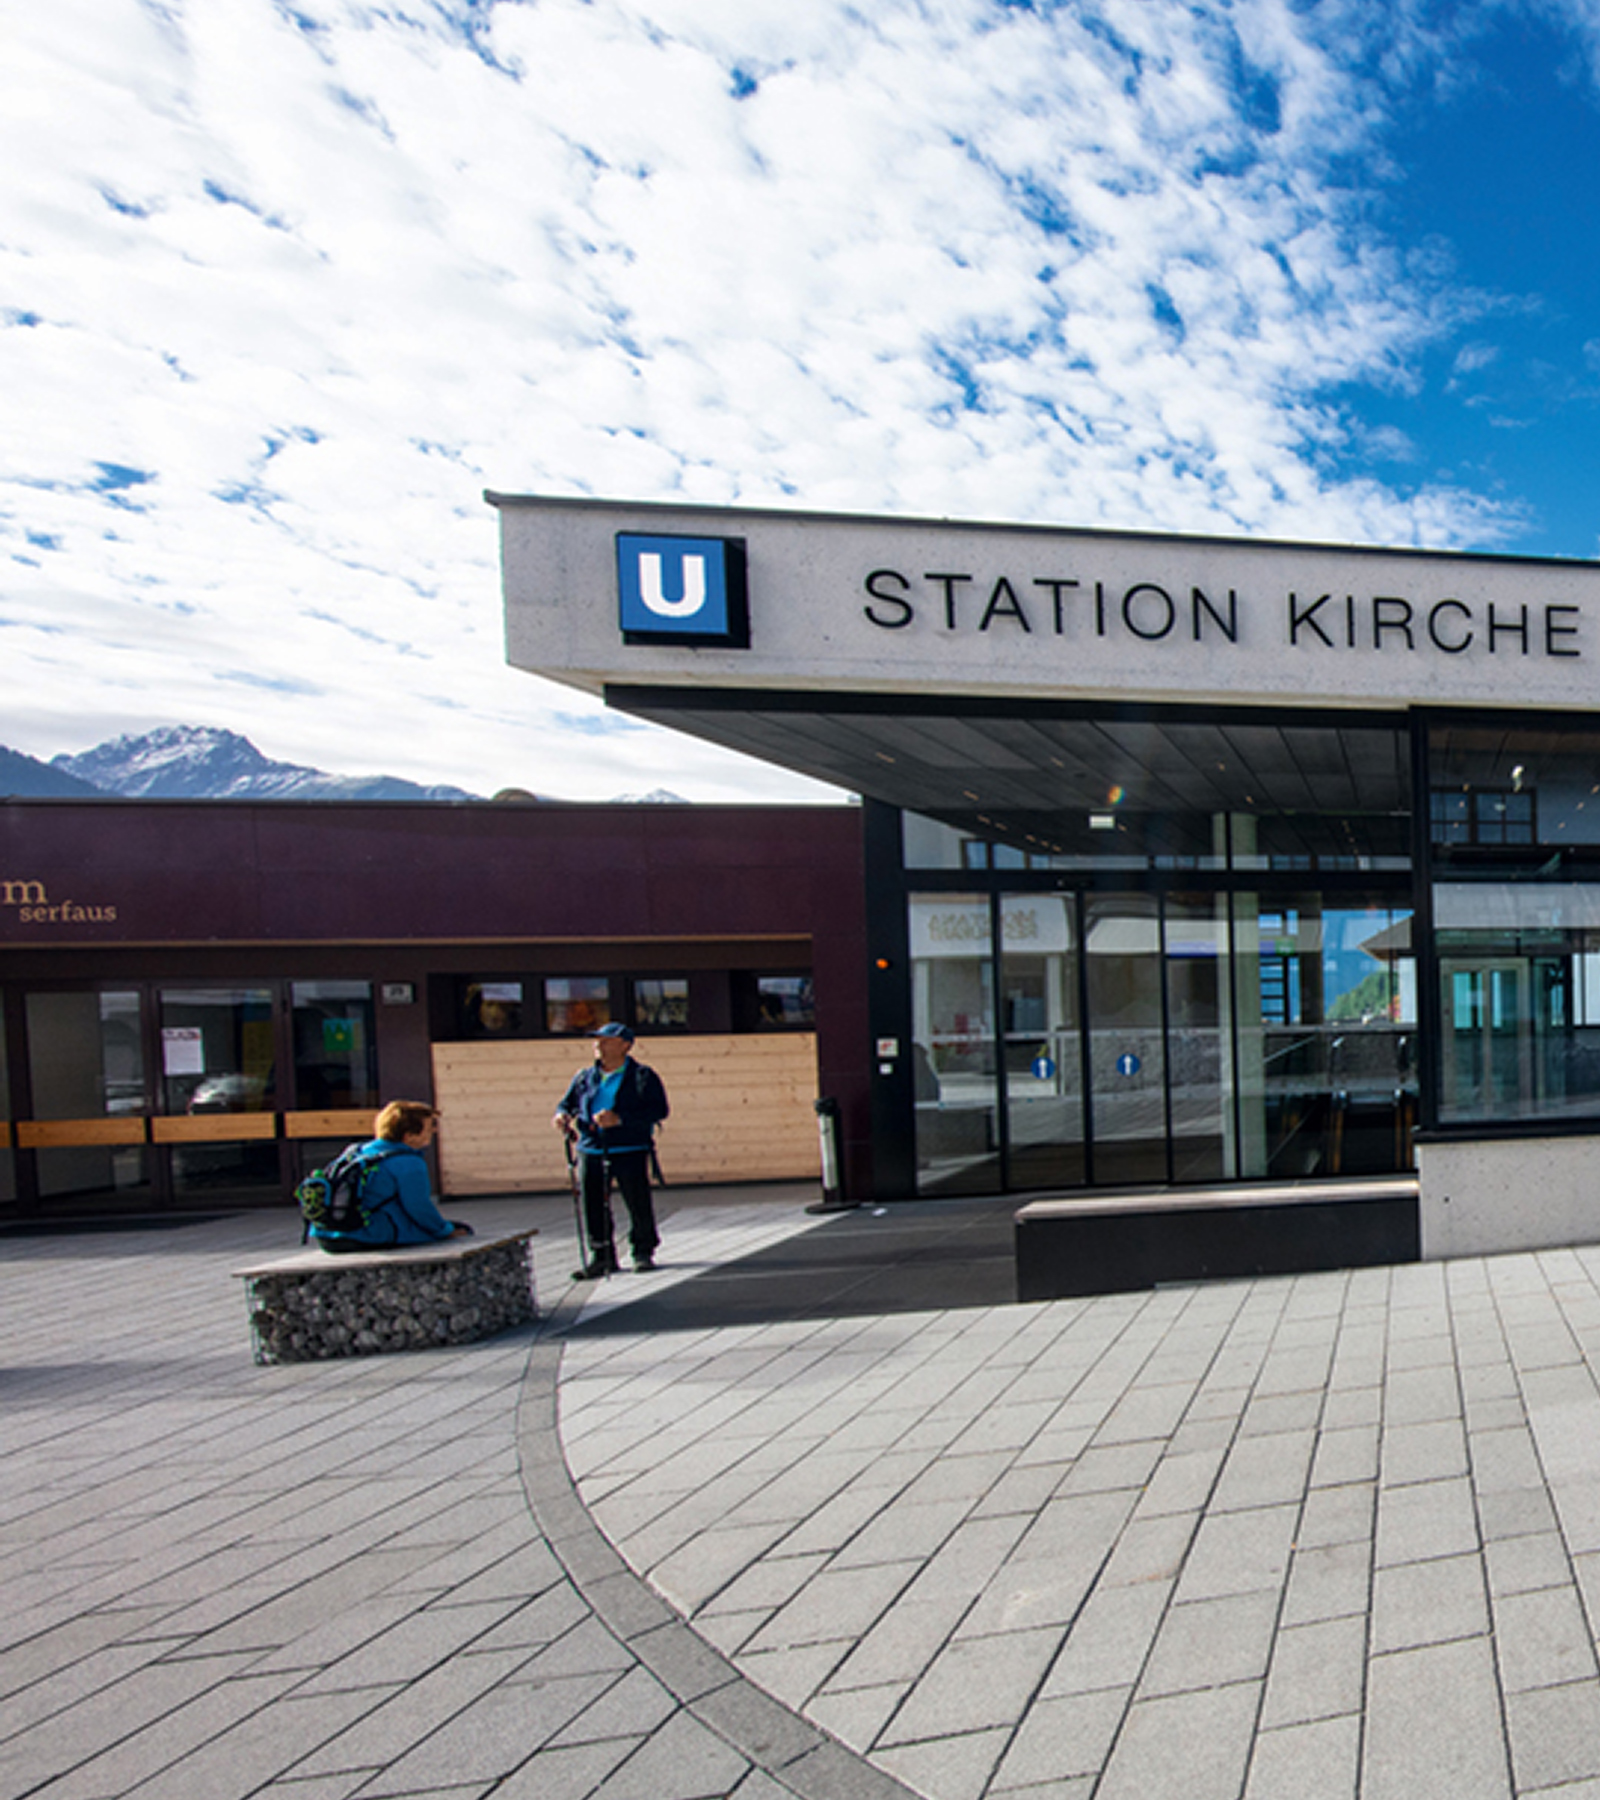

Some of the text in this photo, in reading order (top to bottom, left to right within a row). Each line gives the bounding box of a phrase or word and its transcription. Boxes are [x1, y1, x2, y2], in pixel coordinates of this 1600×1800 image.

[638, 552, 706, 618] U
[863, 569, 1581, 657] STATION KIRCHE
[18, 898, 117, 922] serfaus
